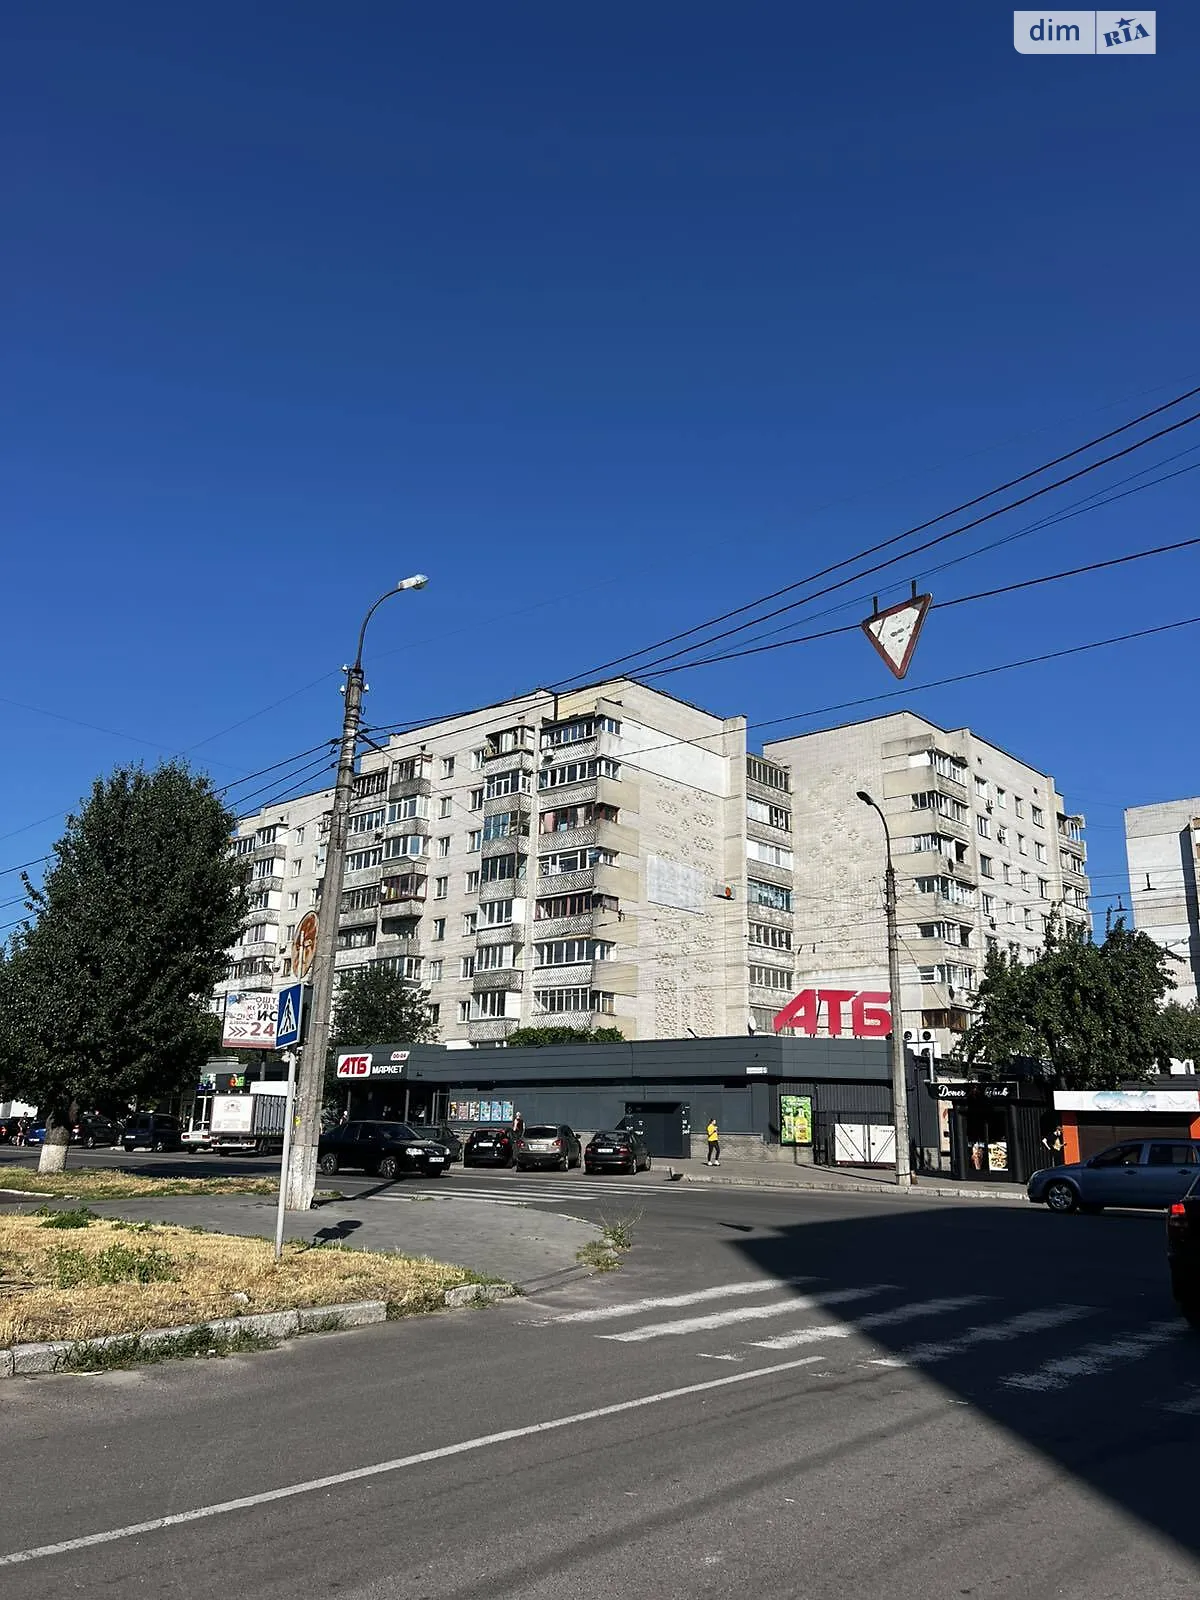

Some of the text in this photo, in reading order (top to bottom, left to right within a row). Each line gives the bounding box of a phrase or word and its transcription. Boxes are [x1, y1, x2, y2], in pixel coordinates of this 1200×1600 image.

[773, 989, 892, 1037] АТБ
[250, 1021, 275, 1037] 24
[339, 1056, 404, 1075] АТБ МАРКЕТ
[938, 1084, 966, 1097] Doner
